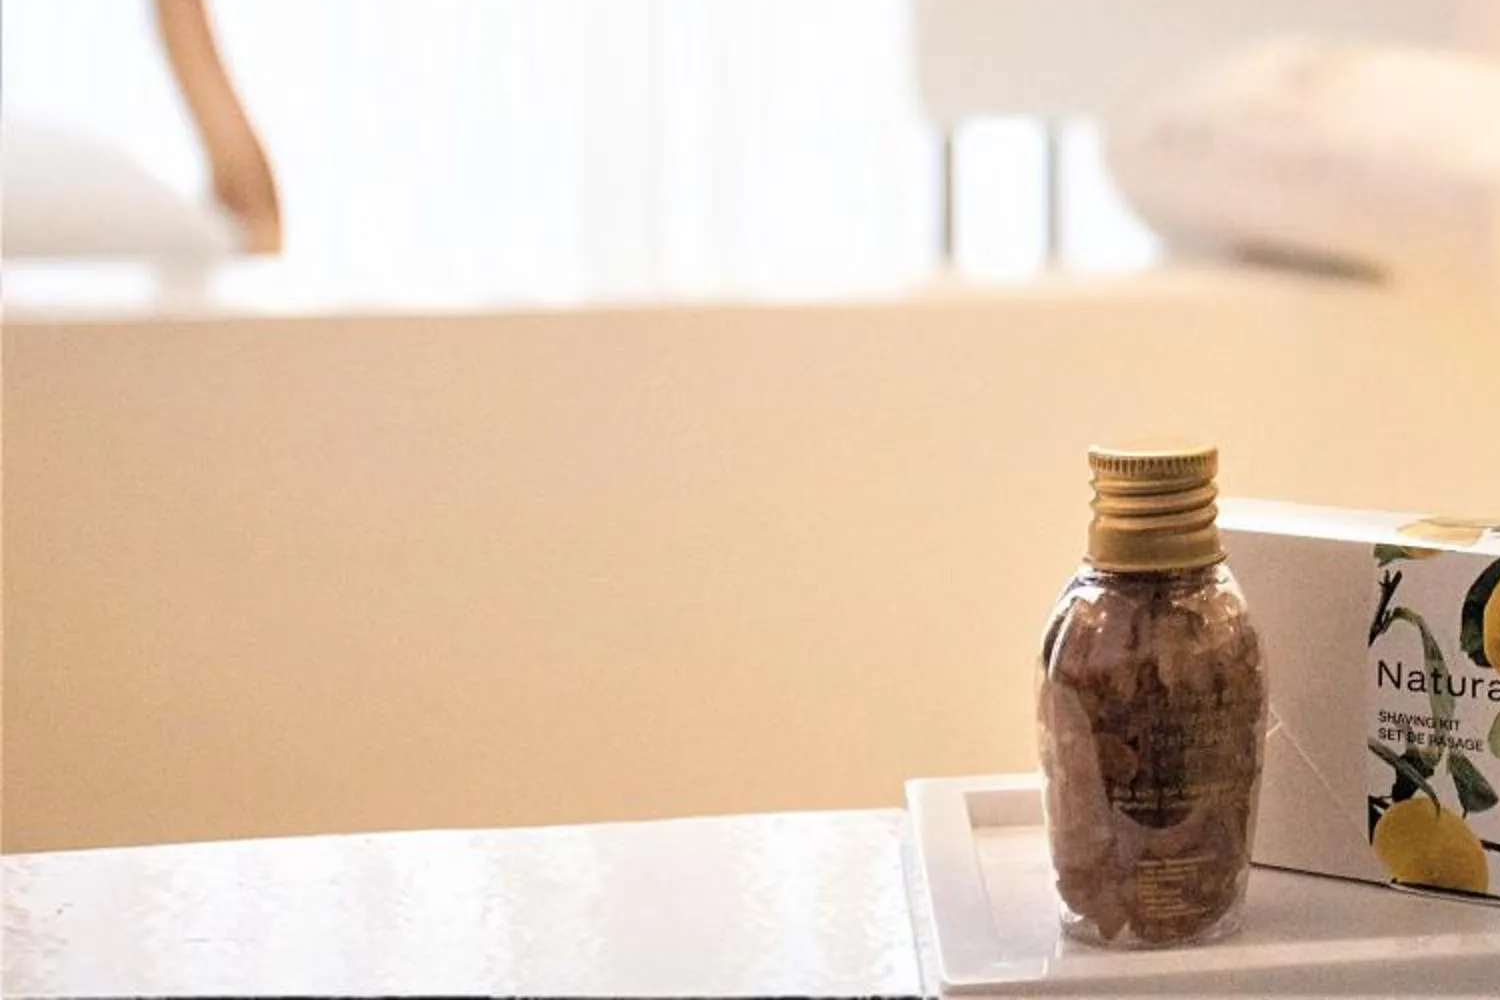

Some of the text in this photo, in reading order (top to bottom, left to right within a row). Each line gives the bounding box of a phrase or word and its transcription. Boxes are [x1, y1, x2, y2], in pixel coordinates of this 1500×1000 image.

[1378, 711, 1460, 731] SHAVING KIT
[1378, 728, 1402, 741] SET
[1407, 731, 1425, 745] DE
